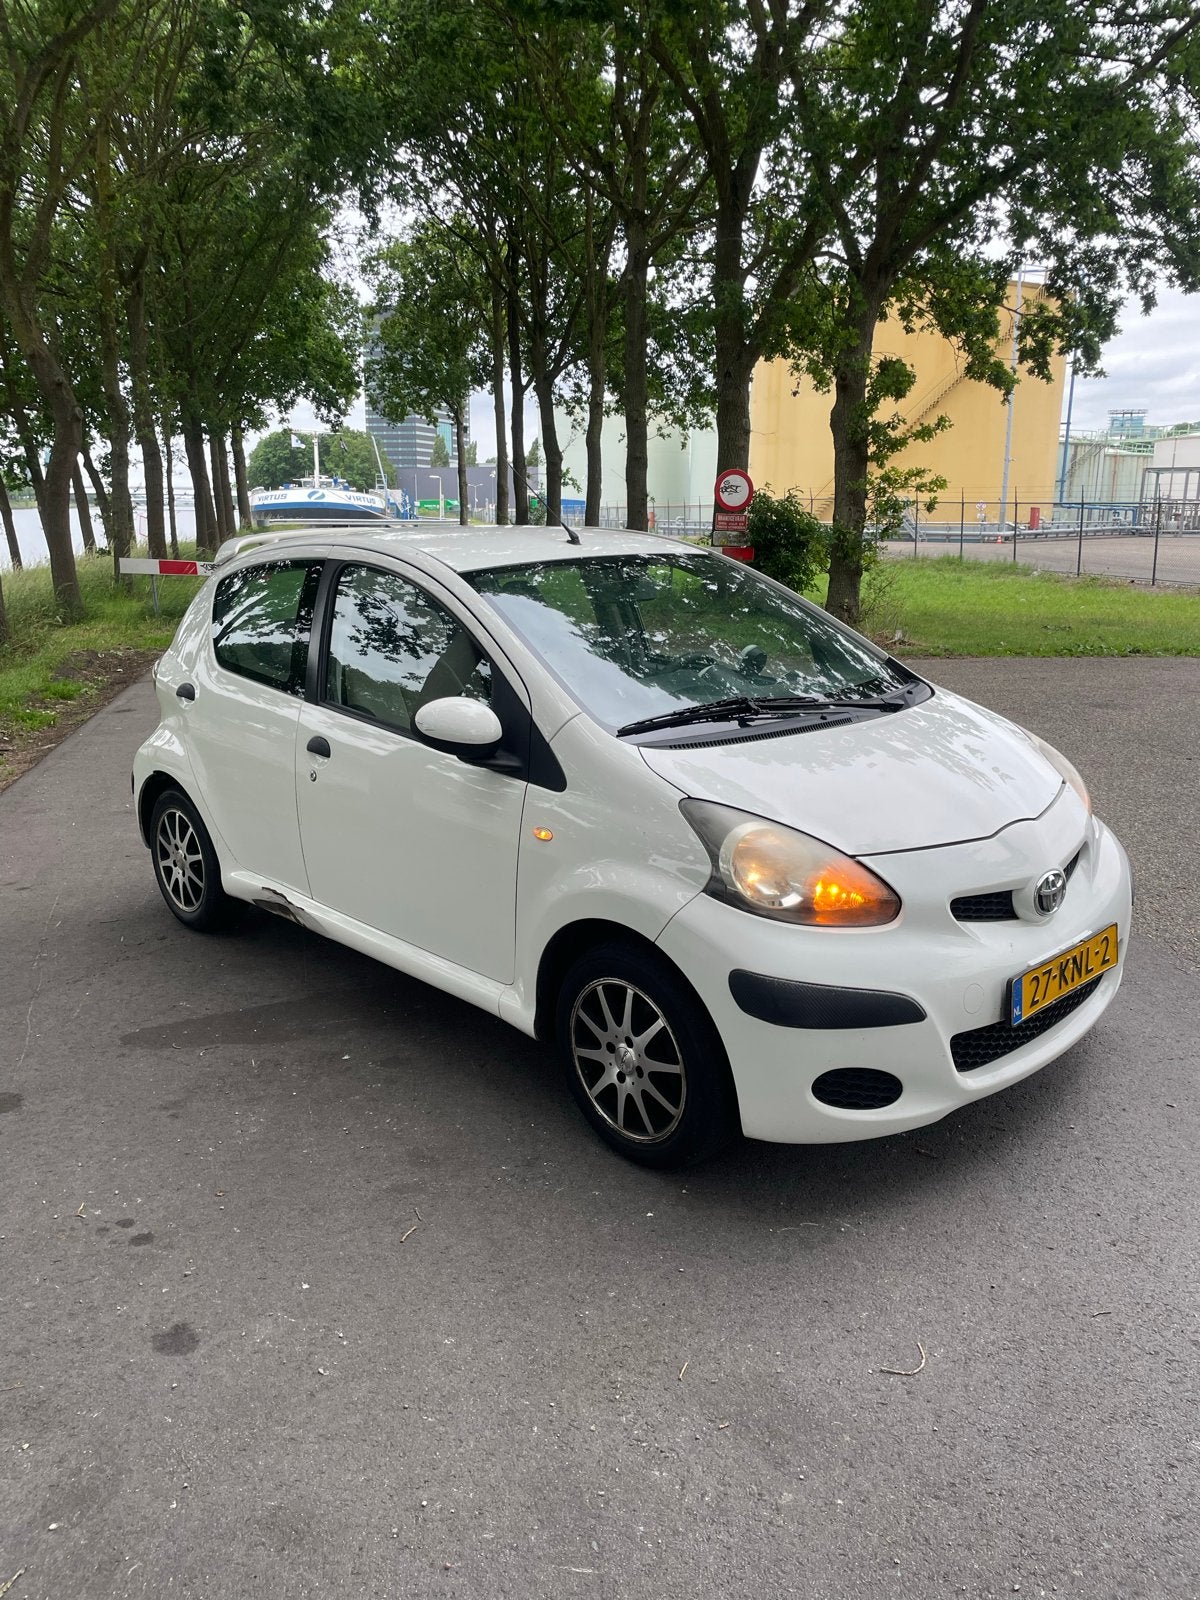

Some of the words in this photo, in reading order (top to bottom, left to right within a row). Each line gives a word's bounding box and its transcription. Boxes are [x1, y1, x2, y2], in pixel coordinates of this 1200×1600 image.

[257, 493, 287, 502] VIRTUS
[345, 494, 376, 504] VIRTUS
[1029, 935, 1111, 1009] 27-KNL-2
[1013, 1007, 1022, 1018] NL
